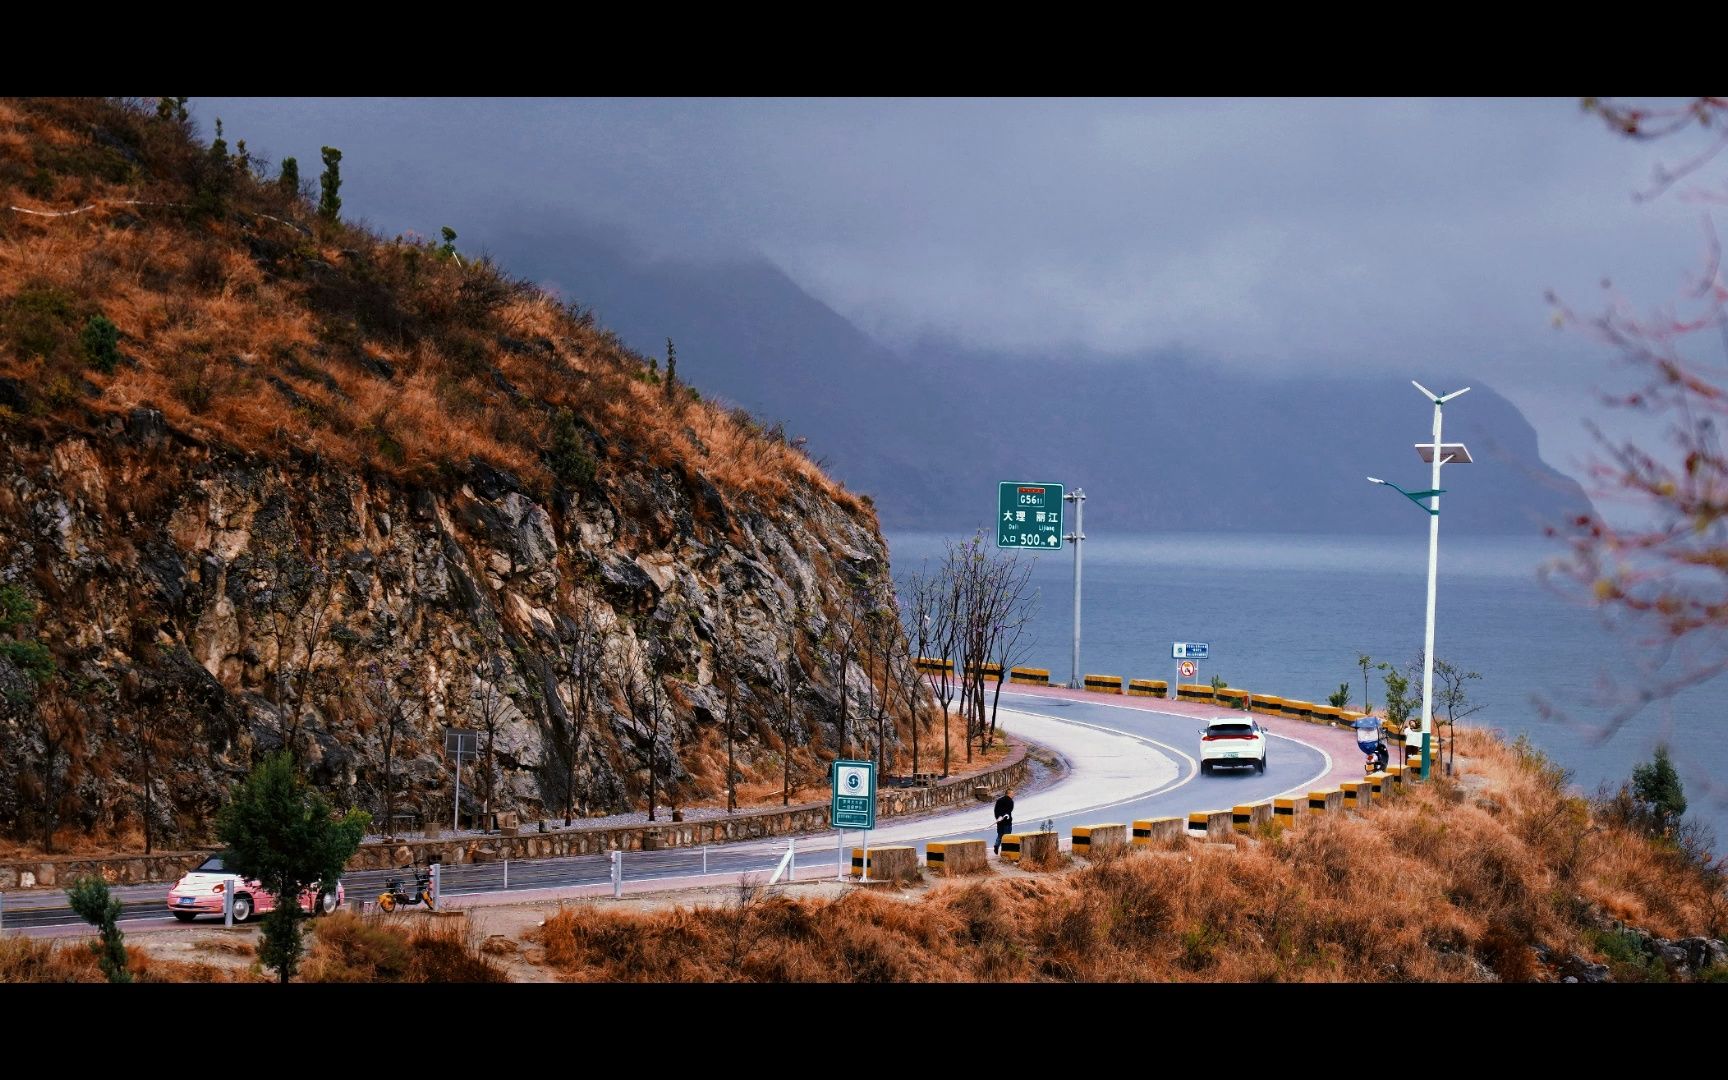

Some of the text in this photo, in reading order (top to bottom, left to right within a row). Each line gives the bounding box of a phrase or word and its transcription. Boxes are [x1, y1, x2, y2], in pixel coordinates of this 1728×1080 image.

[1020, 495, 1043, 504] G5611
[1003, 510, 1058, 523] 大理 丽江
[1002, 535, 1016, 543] 入口
